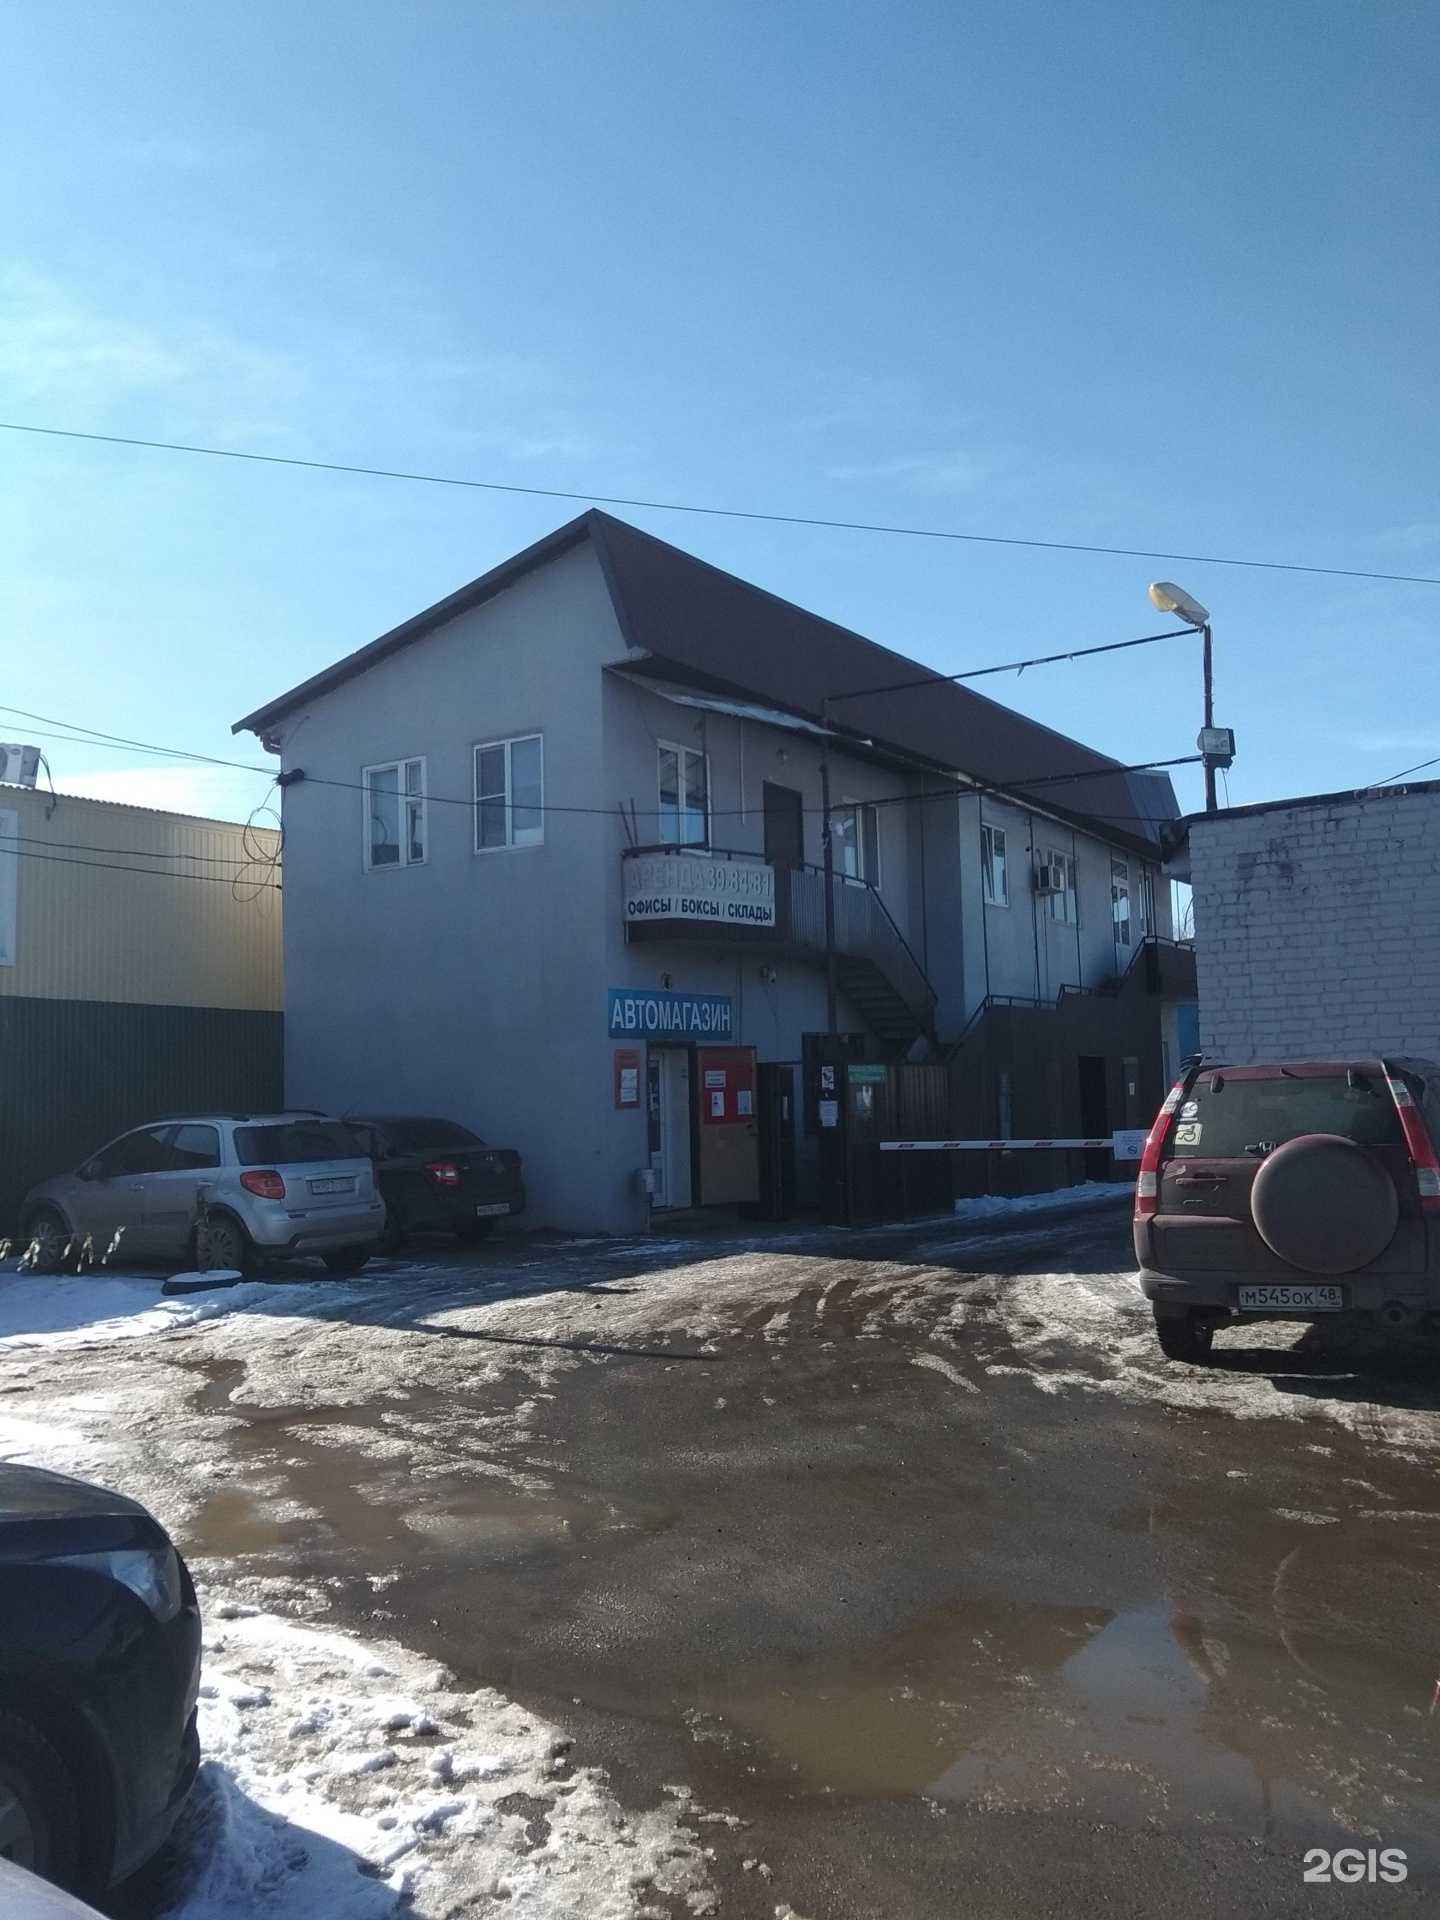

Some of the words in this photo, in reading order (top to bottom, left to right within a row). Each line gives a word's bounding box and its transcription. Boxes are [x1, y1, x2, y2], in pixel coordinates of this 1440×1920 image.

[628, 898, 671, 915] ОФИСЫ
[681, 899, 720, 915] БОКСЫ
[727, 903, 771, 922] СКЛАДЫ
[611, 998, 730, 1031] АВТОМАГАЗИН
[1319, 1287, 1337, 1300] 48
